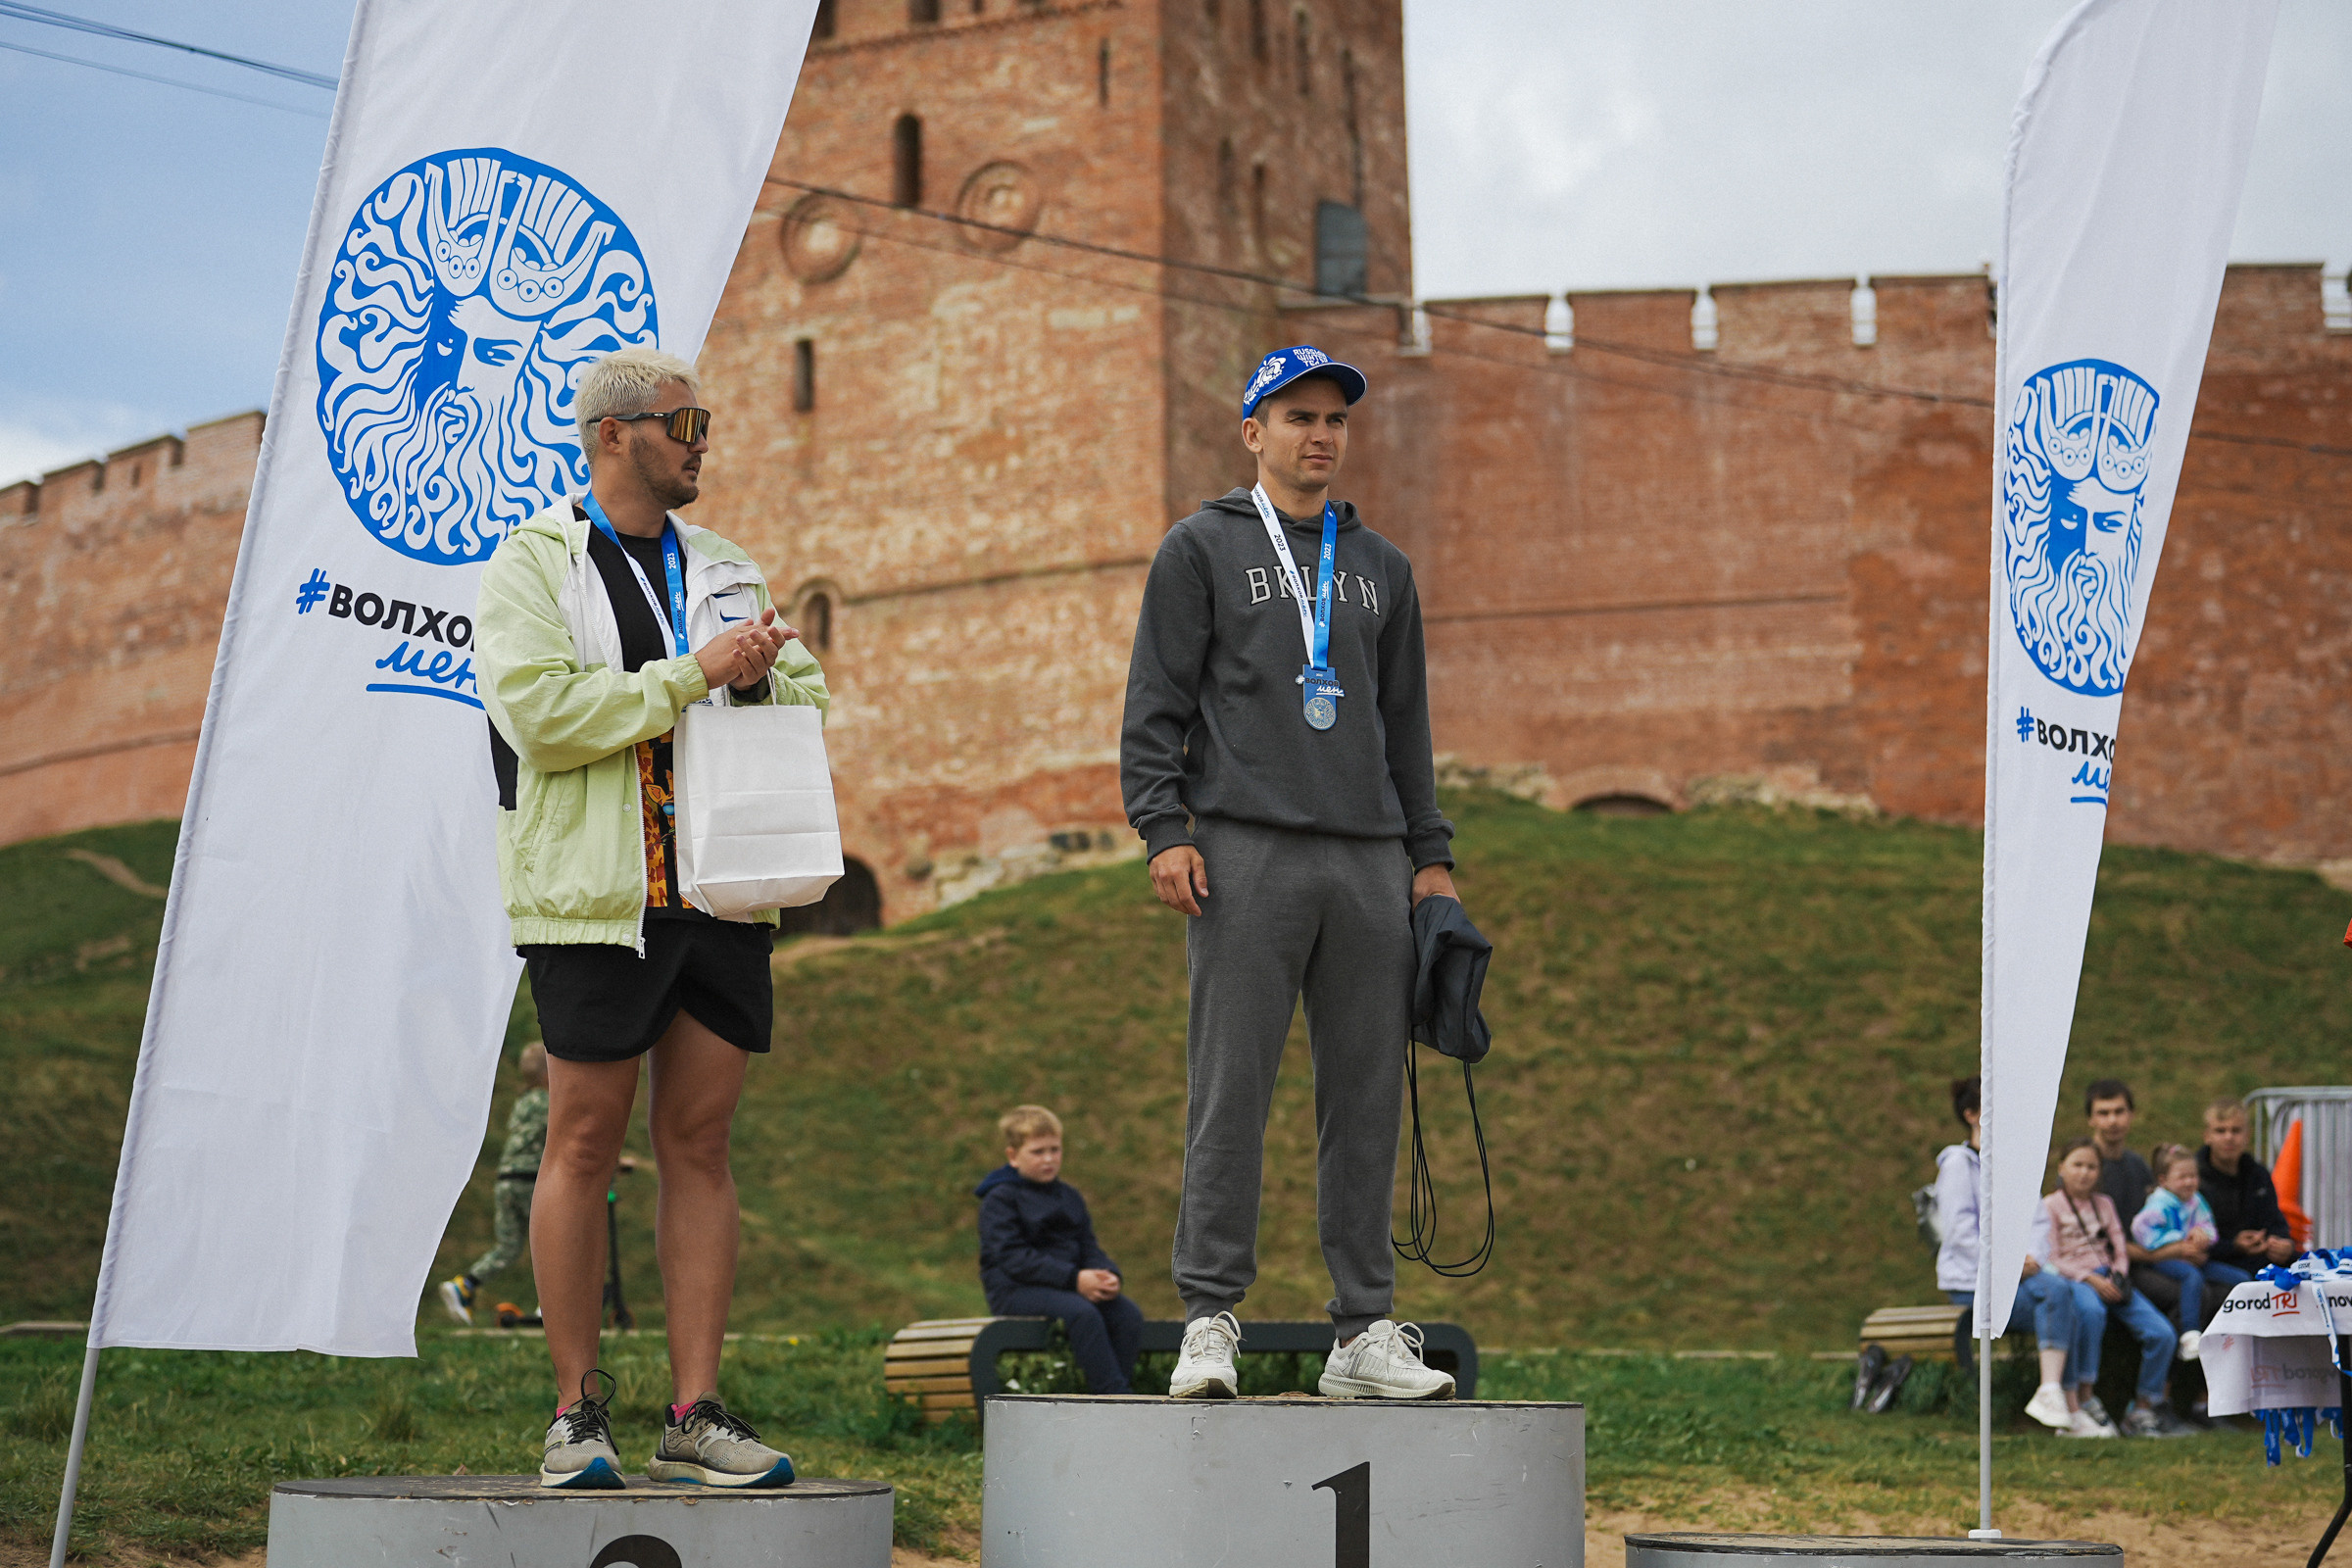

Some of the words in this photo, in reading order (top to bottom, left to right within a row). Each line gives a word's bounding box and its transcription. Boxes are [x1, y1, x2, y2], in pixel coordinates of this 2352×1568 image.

[1274, 533, 1286, 552] 2023
[1324, 543, 1333, 561] 2023
[666, 552, 676, 569] 2023
[1245, 565, 1380, 616] BKLYN
[296, 567, 475, 653] #ВОЛХО
[1311, 1461, 1370, 1568] 1
